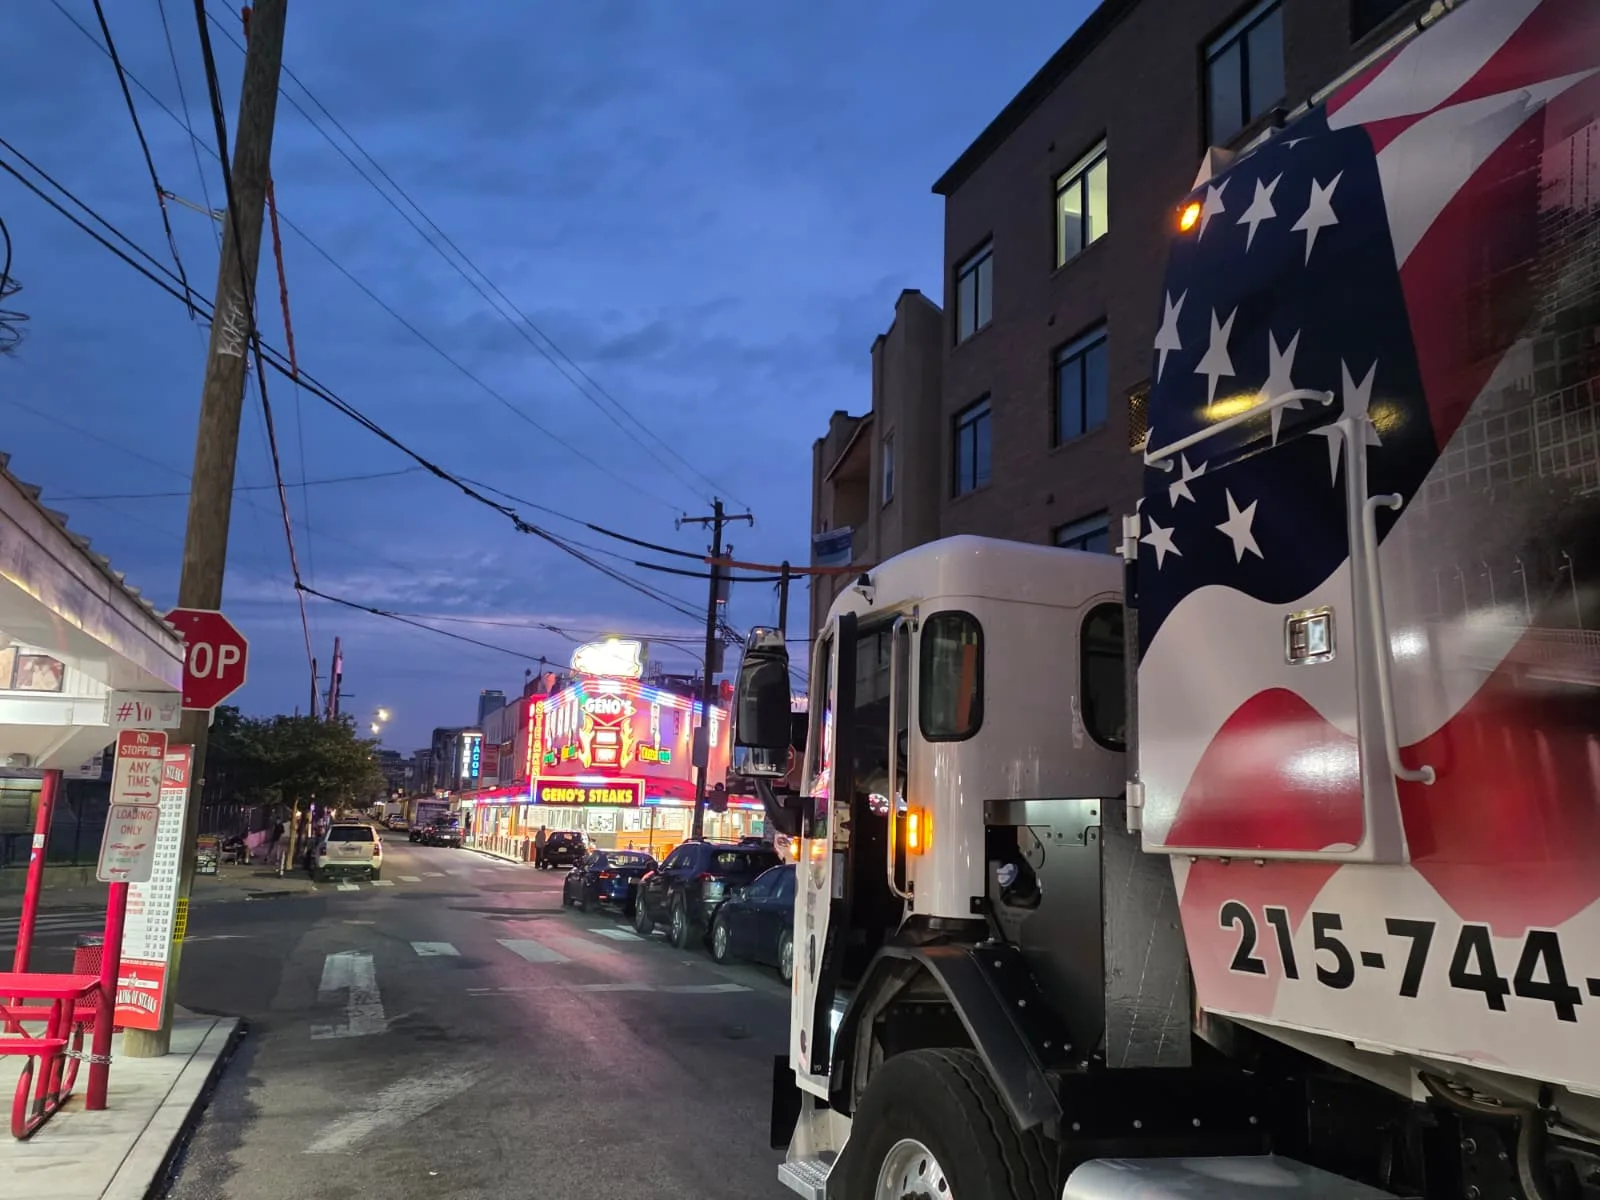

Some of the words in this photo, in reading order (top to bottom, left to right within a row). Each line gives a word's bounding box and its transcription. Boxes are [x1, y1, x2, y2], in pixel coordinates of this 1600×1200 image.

[184, 641, 240, 679] OP
[116, 702, 152, 722] #Yo
[585, 698, 633, 714] GENO'S
[136, 732, 149, 744] NO
[531, 701, 544, 776] STEAKS
[472, 738, 481, 777] TACOS
[128, 762, 151, 774] ANY
[127, 775, 151, 788] TIME
[541, 788, 585, 802] GENO'S
[589, 789, 633, 803] STEAKS
[116, 808, 153, 821] LOADING
[120, 824, 142, 835] ONLY
